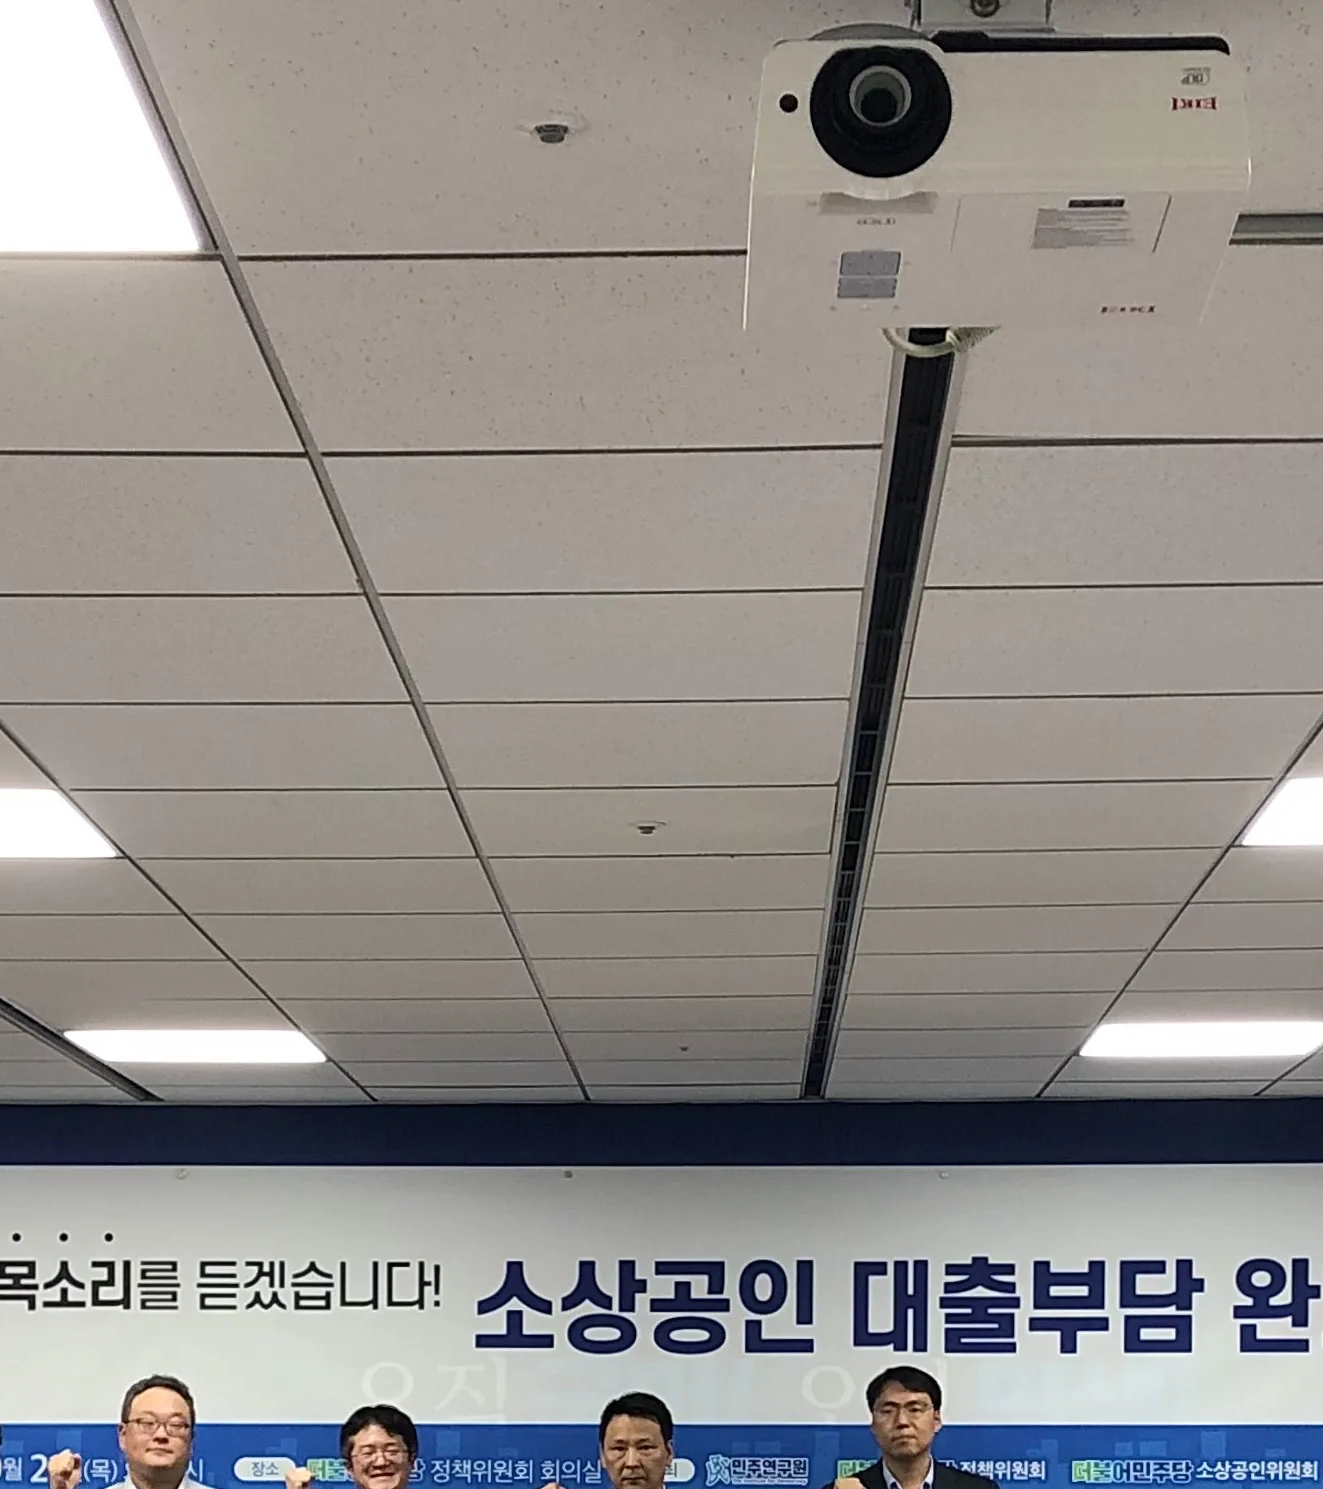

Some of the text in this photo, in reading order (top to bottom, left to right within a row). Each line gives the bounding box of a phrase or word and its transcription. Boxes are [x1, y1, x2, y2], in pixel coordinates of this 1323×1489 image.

[1171, 96, 1217, 111] EIKI
[196, 1258, 442, 1312] 듣겠습니다!
[474, 1257, 817, 1355] 소상공인
[852, 1255, 1206, 1355] 대출부담
[251, 1460, 279, 1477] 장소
[431, 1458, 535, 1484] 정책위원회
[540, 1459, 602, 1485] 회의실
[731, 1458, 809, 1478] 민주연구원
[1072, 1459, 1319, 1483] 더불어민주당 소상공인위원회
